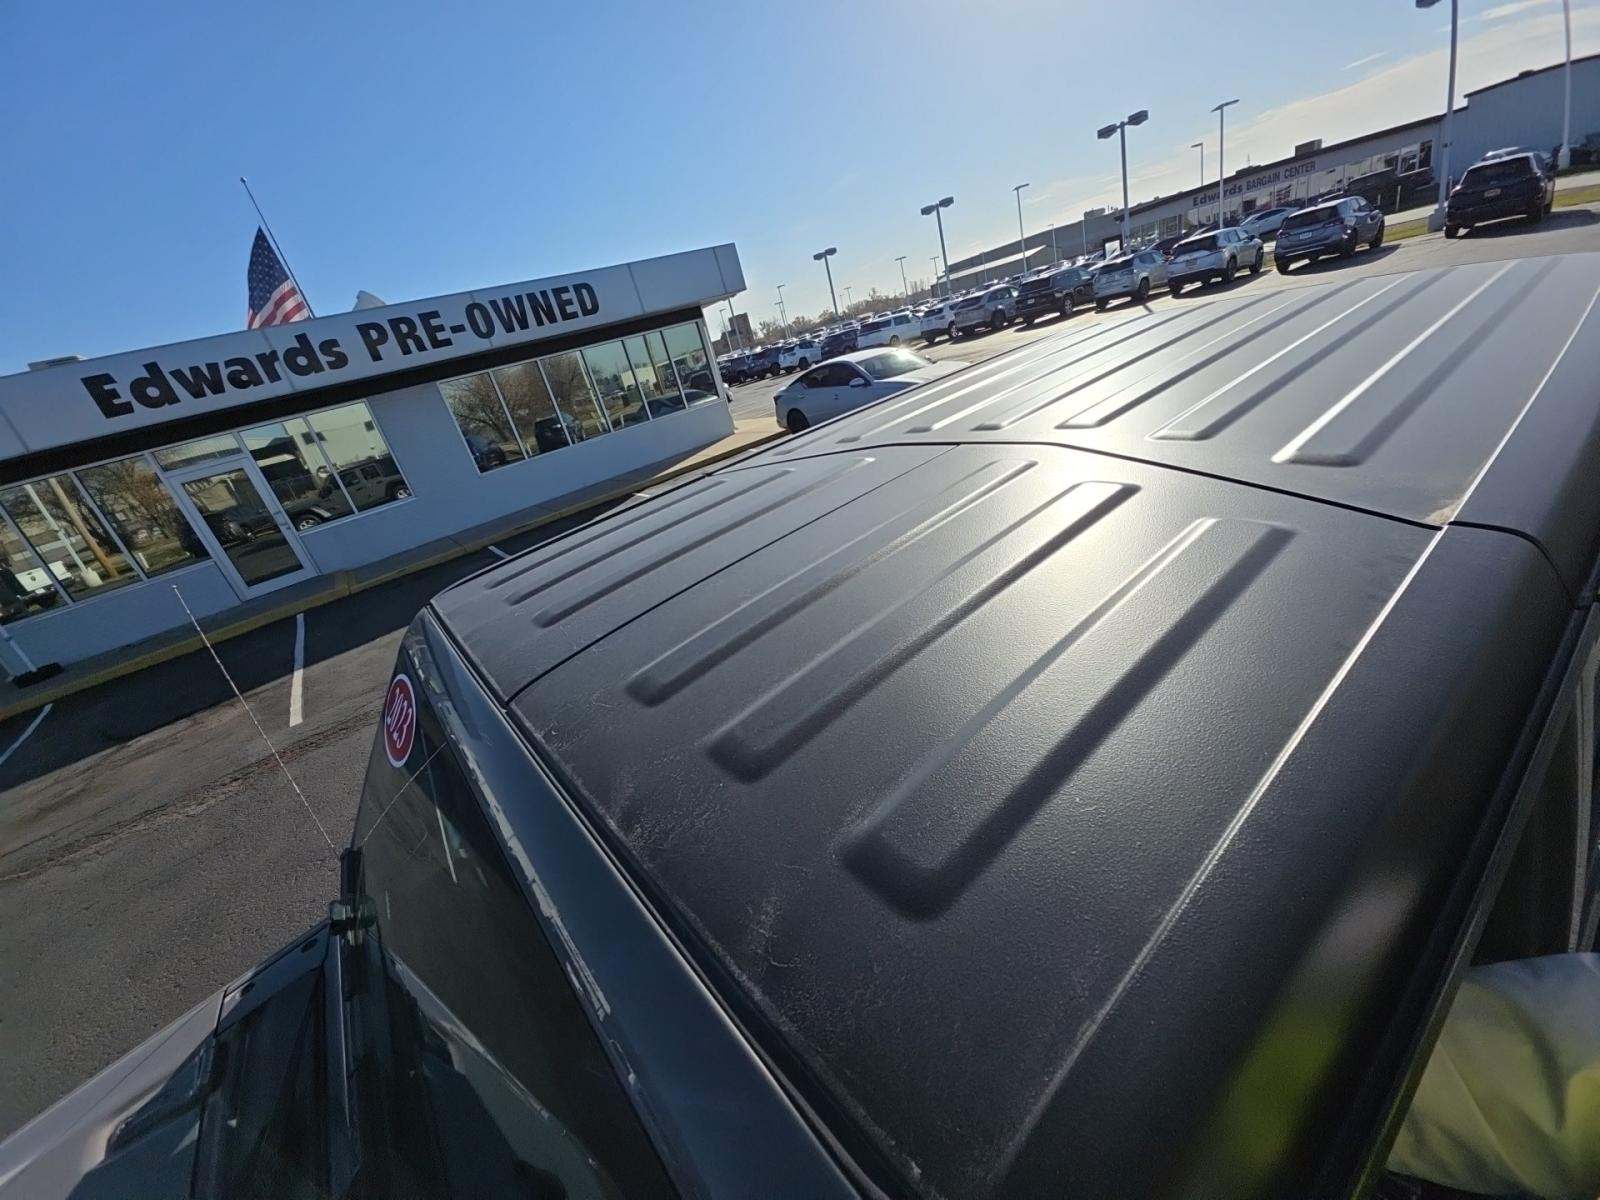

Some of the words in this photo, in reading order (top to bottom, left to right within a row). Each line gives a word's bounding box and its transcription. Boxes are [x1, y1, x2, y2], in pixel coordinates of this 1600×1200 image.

[1246, 172, 1281, 191] BARGAIN
[1285, 161, 1316, 179] CENTER
[81, 333, 348, 418] Edwards
[355, 282, 600, 362] PRE-OWNED
